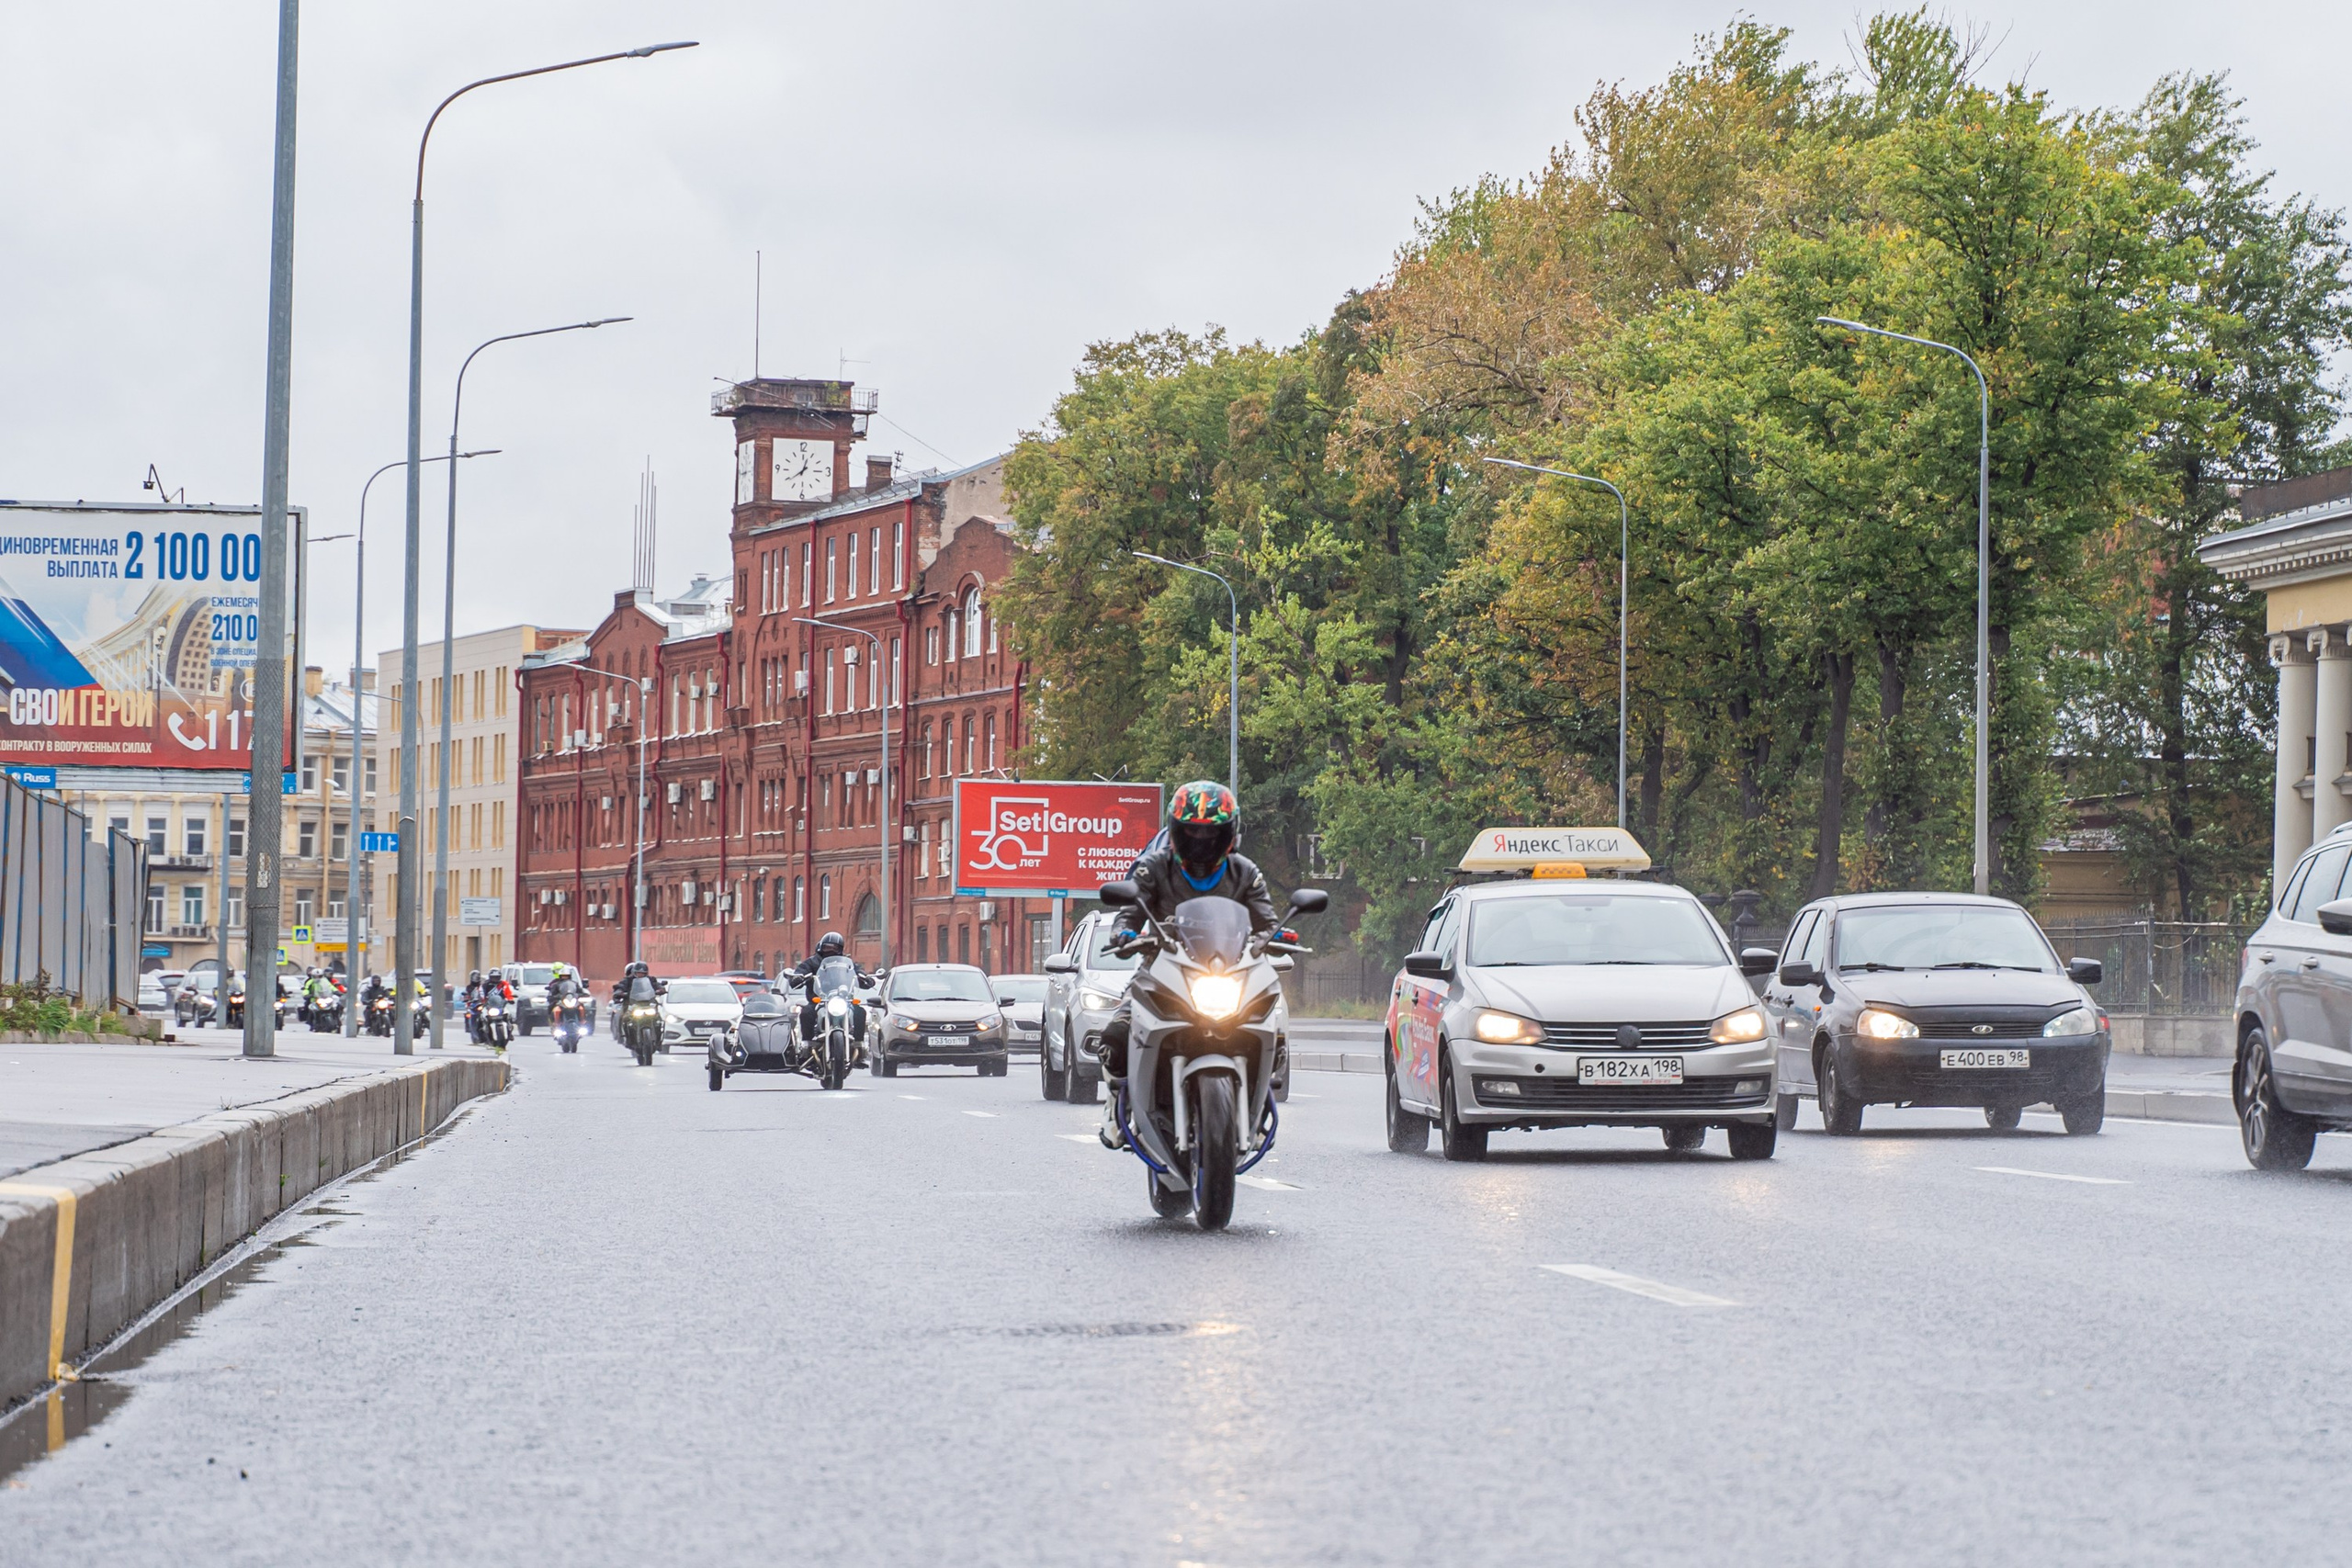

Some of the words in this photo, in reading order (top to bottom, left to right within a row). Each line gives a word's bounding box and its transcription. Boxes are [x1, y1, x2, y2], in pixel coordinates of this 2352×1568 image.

[775, 464, 780, 474] 9
[825, 466, 831, 477] 3
[799, 489, 805, 500] 6
[124, 531, 143, 579] 2
[153, 532, 209, 581] 100
[220, 533, 261, 581] 00
[48, 560, 118, 578] ВЫПЛАТА
[211, 597, 258, 607] ЕЖЕМЕСЯЧ
[211, 614, 242, 641] 210
[247, 615, 257, 641] 0
[232, 648, 257, 656] СПЕЦИА
[210, 659, 238, 667] ВОЕННОЙ
[10, 688, 74, 726] СВОИ
[79, 689, 153, 727] ГЕРОИ
[47, 741, 52, 751] В
[54, 741, 121, 752] ВООРУЖЕННЫХ
[122, 742, 152, 753] СИЛАХ
[23, 773, 51, 783] Russ
[1494, 834, 1561, 853] Яндекс
[1564, 834, 1619, 852] Такси
[969, 830, 1028, 870] 30
[1078, 848, 1085, 856] С
[1088, 848, 1143, 857] ЛЮБОВЬ
[1020, 858, 1041, 867] лет
[1079, 860, 1086, 868] К
[1089, 860, 1135, 870] КАЖДО
[1947, 1052, 2005, 1066] Е400ЕВ
[1584, 1061, 1650, 1077] В182ХА
[1654, 1060, 1678, 1072] 198
